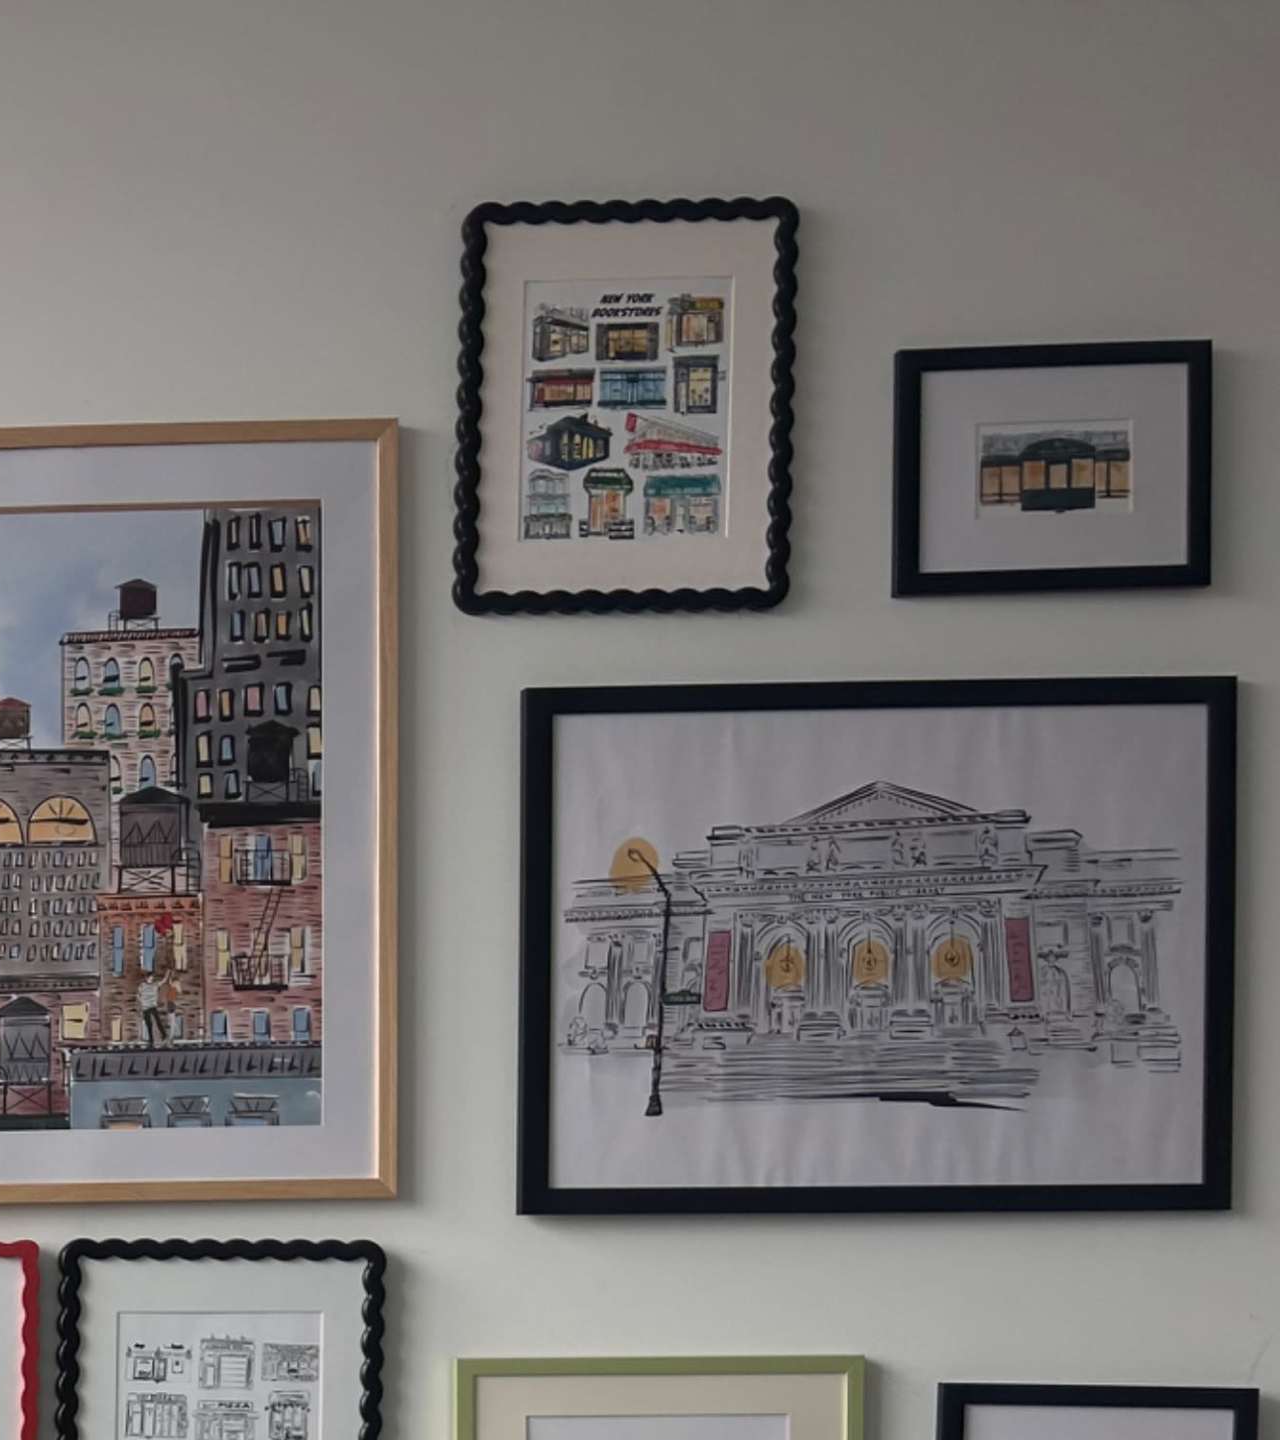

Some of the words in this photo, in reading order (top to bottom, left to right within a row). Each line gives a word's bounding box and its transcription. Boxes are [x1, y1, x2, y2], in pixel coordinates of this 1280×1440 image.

[600, 294, 624, 304] NEW
[627, 293, 654, 304] YORK
[591, 306, 663, 318] BOOKSTORES
[217, 1401, 250, 1409] PIZZA
